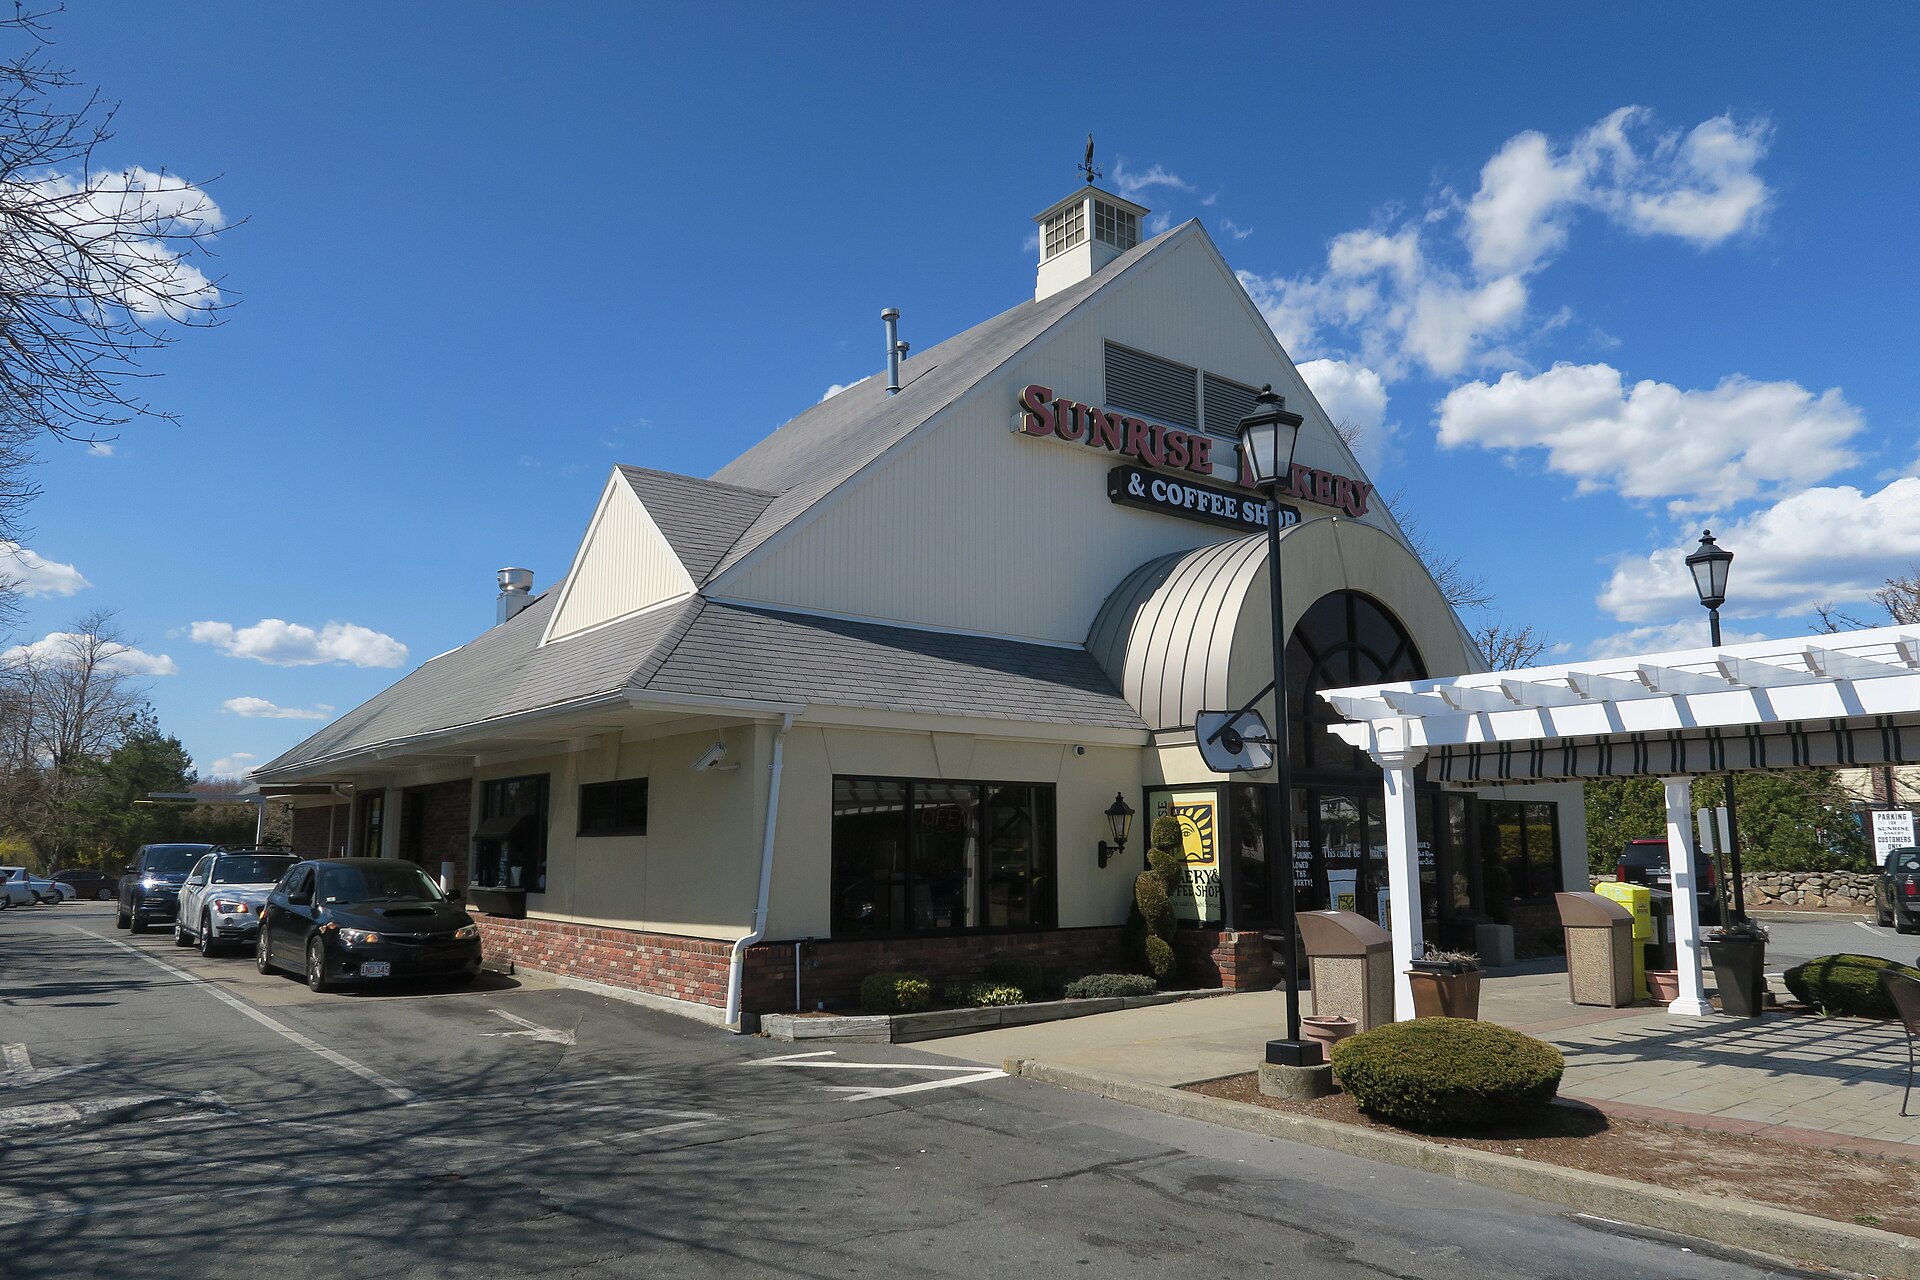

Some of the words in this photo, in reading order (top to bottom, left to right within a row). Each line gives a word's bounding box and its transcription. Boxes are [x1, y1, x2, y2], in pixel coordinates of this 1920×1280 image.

[1019, 384, 1213, 475] SUNRISE
[1236, 443, 1374, 518] KERY
[1128, 472, 1146, 497] &
[1151, 479, 1238, 519] COFFEE
[1322, 846, 1336, 858] This
[1336, 846, 1352, 858] could
[1195, 885, 1220, 898] SHOP
